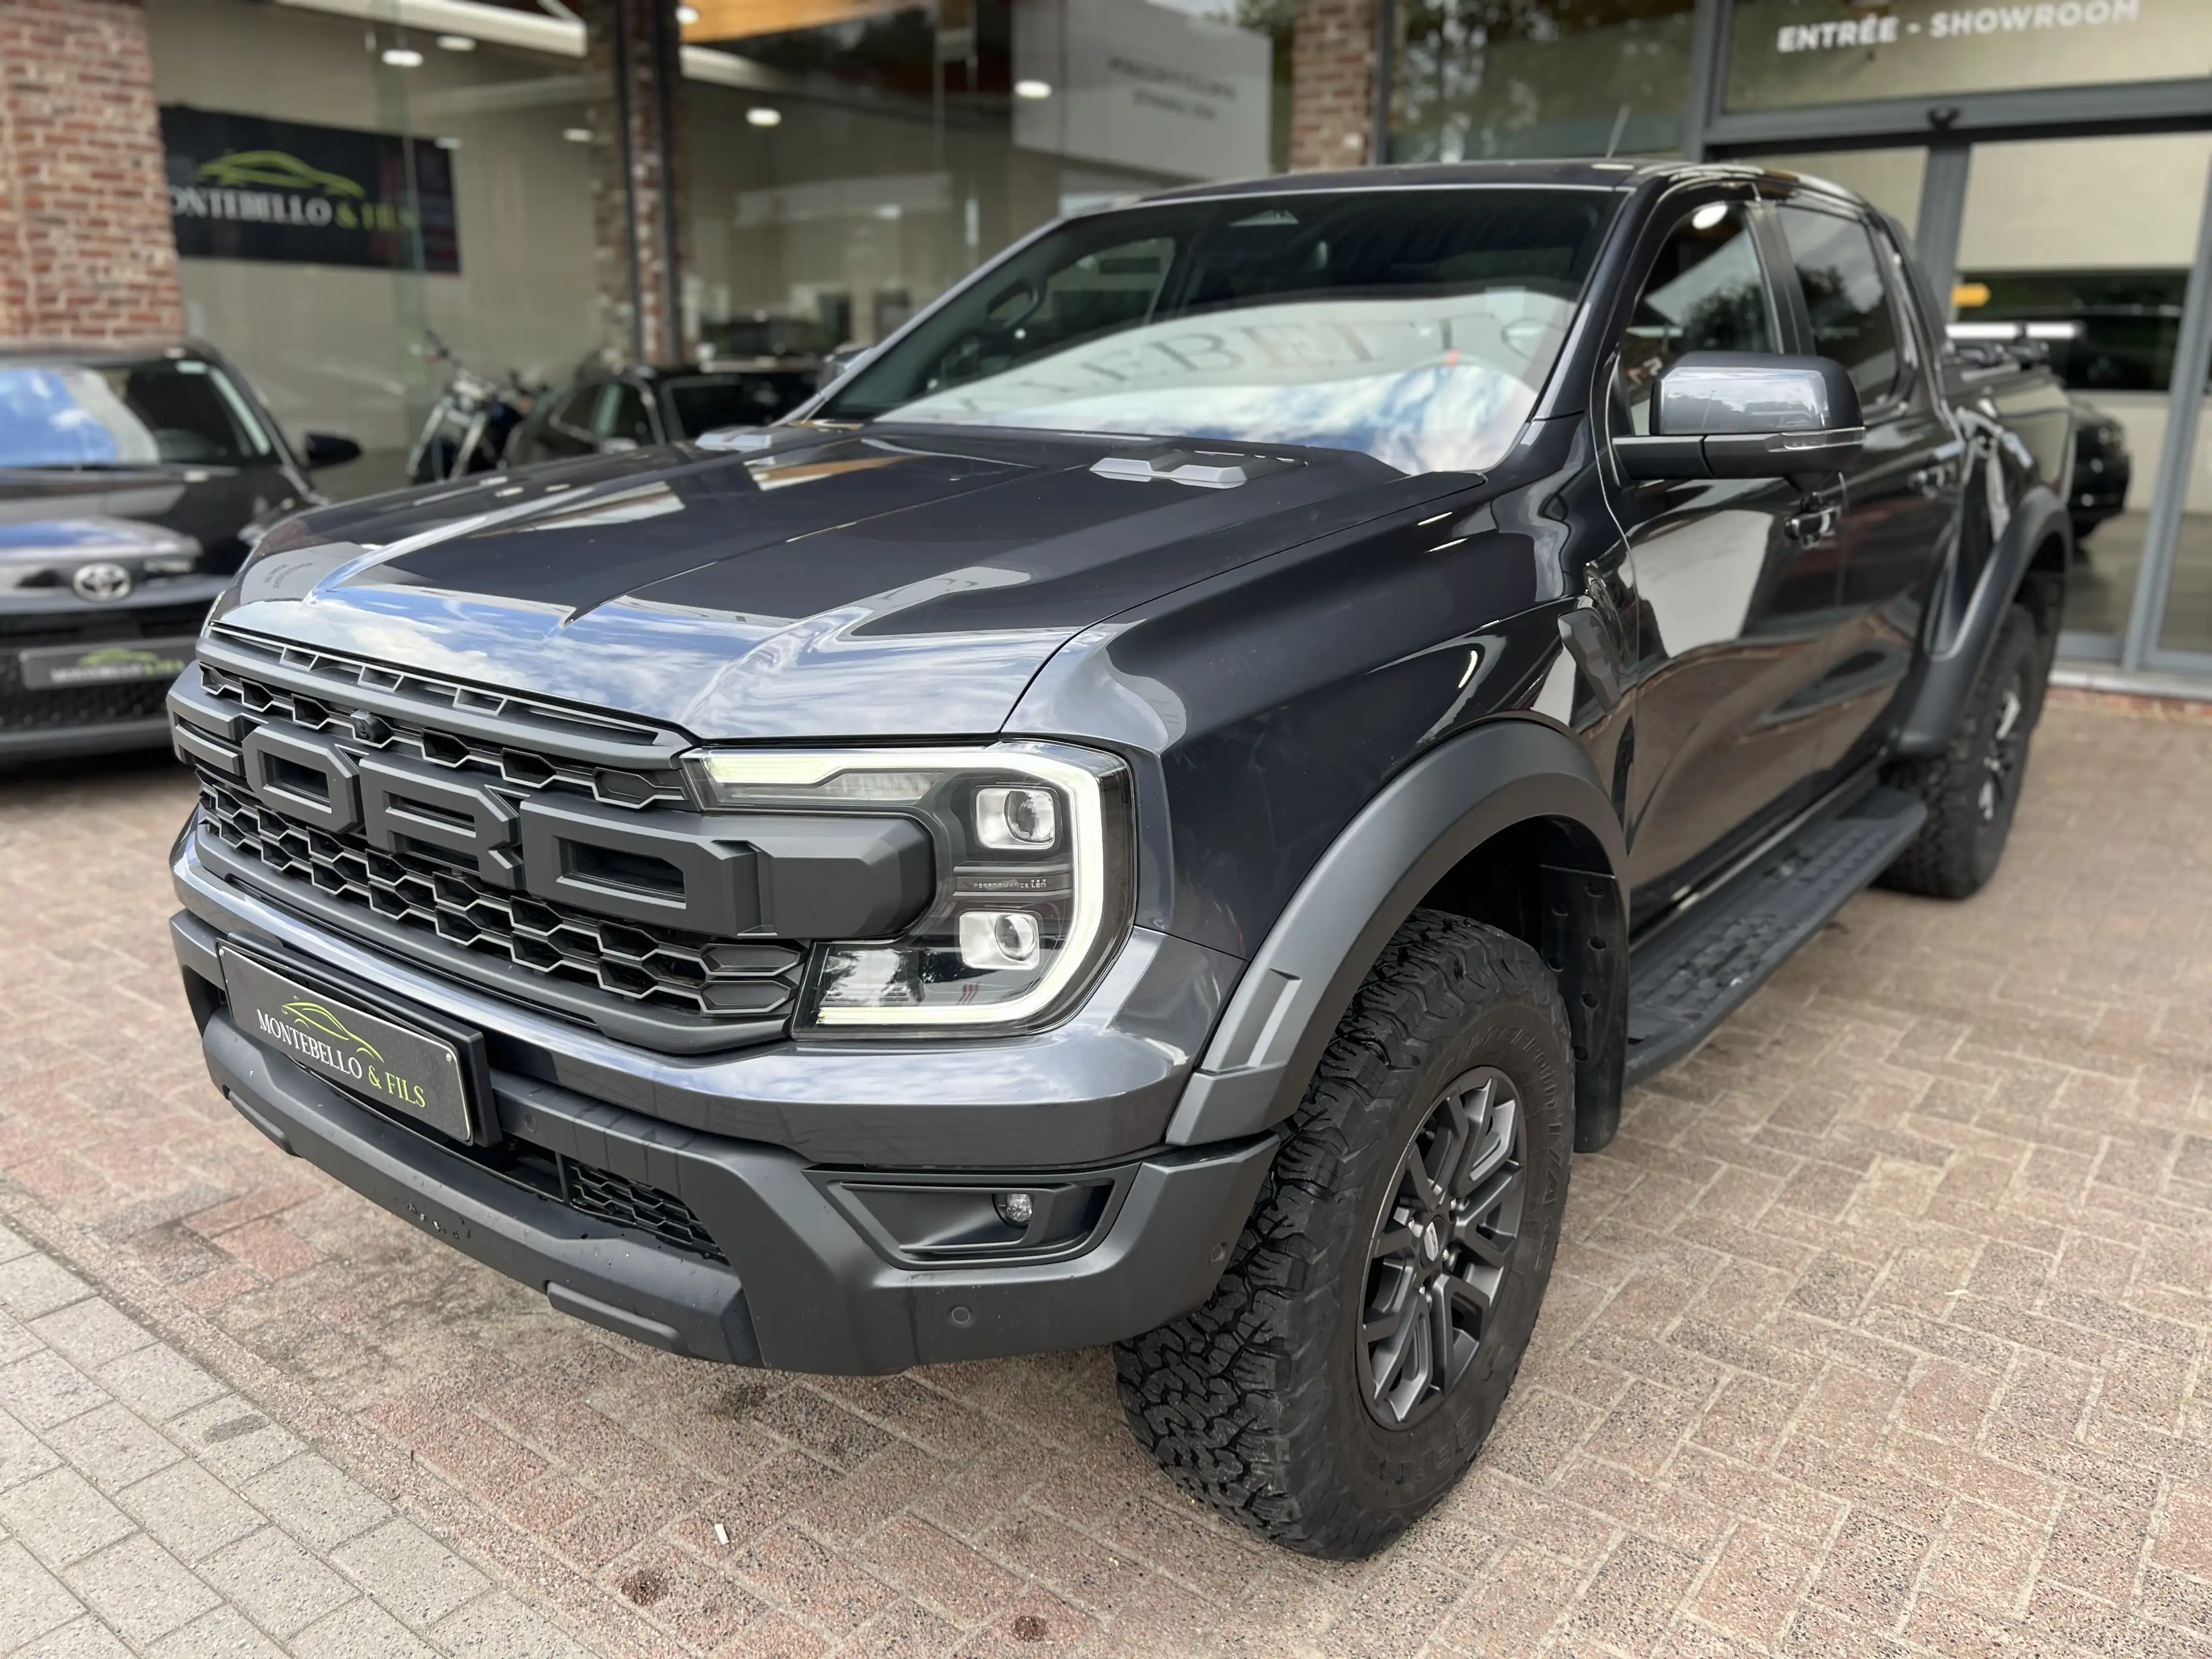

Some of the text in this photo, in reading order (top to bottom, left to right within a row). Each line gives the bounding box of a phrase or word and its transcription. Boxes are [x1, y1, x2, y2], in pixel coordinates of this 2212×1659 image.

[1777, 12, 1899, 52] ENTRÉE
[1929, 0, 2139, 38] SHOWROOM
[166, 691, 749, 938] FORD
[1031, 878, 1047, 888] LED
[257, 1009, 426, 1108] MONTEBELLO & FILS
